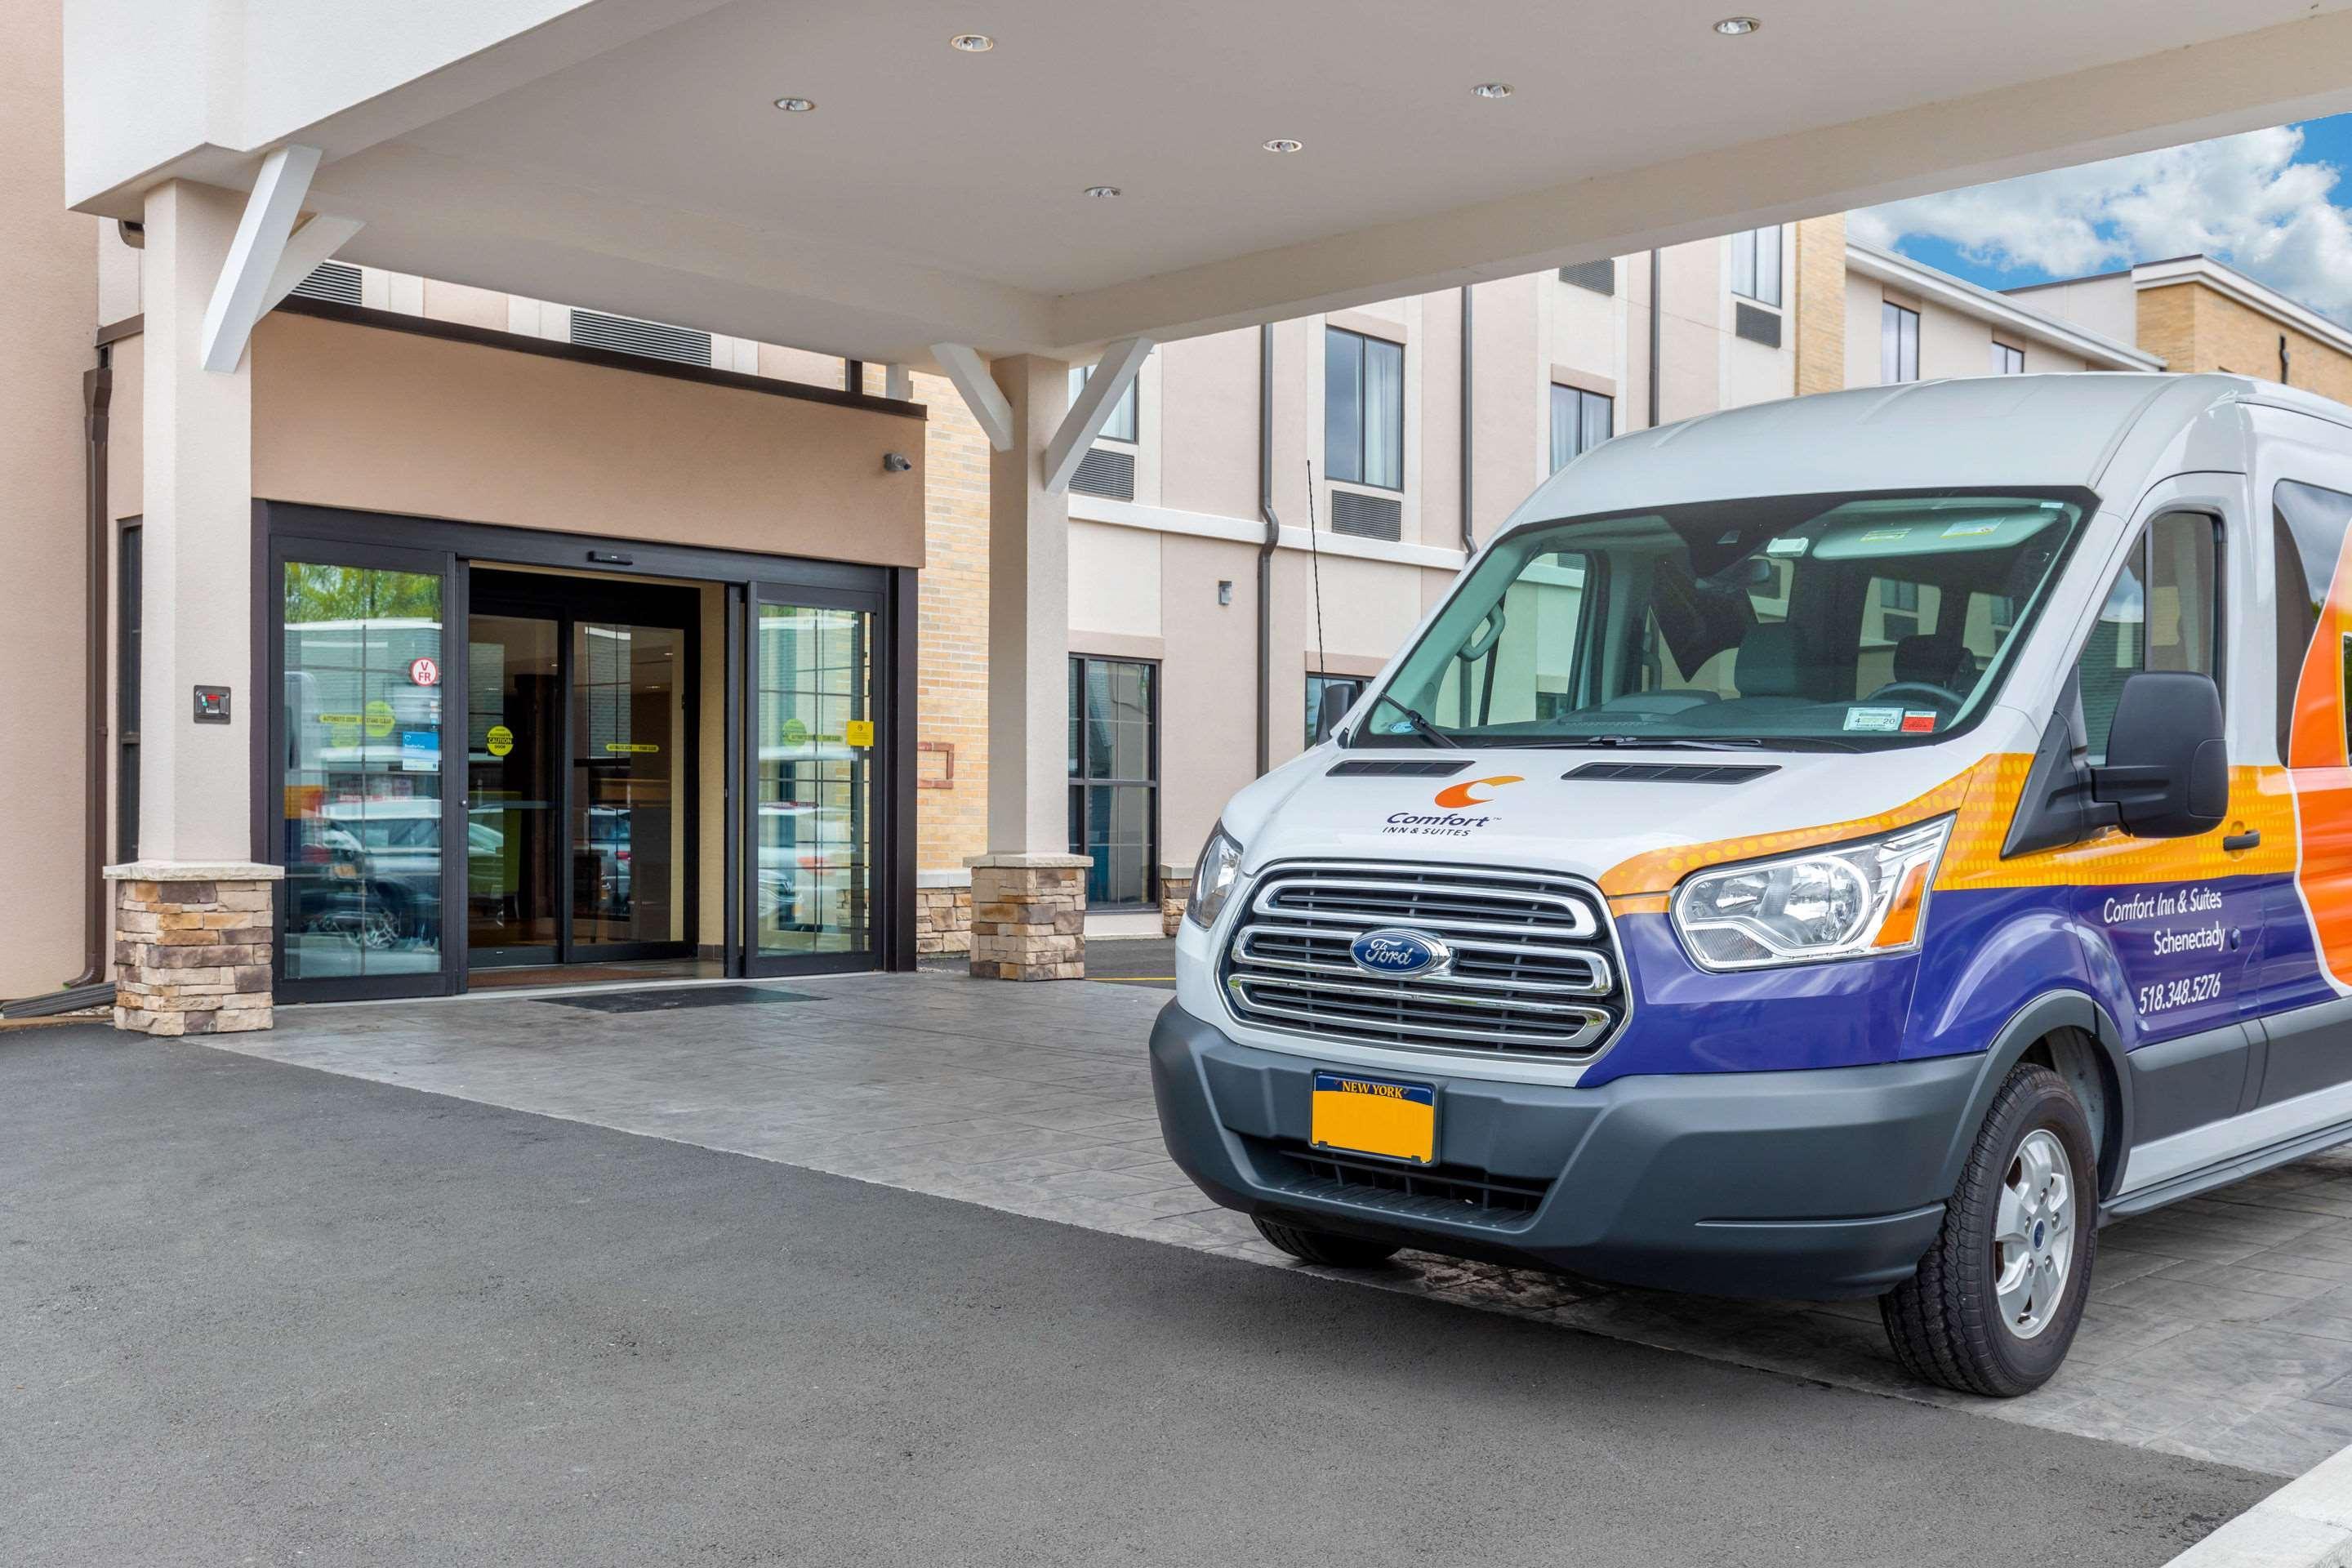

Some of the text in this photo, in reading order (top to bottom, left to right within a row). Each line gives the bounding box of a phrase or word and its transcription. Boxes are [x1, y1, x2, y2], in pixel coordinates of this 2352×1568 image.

[421, 662, 429, 671] V
[418, 671, 431, 682] FR
[1387, 813, 1490, 828] Comfort
[1422, 828, 1470, 836] SUITES
[2104, 888, 2221, 924] Comfort Inn & Suites
[2154, 921, 2225, 956] Schenectady
[1365, 938, 1414, 965] Ford
[2139, 973, 2221, 1014] 518.348.5276
[1342, 1080, 1404, 1099] NEW YORK
